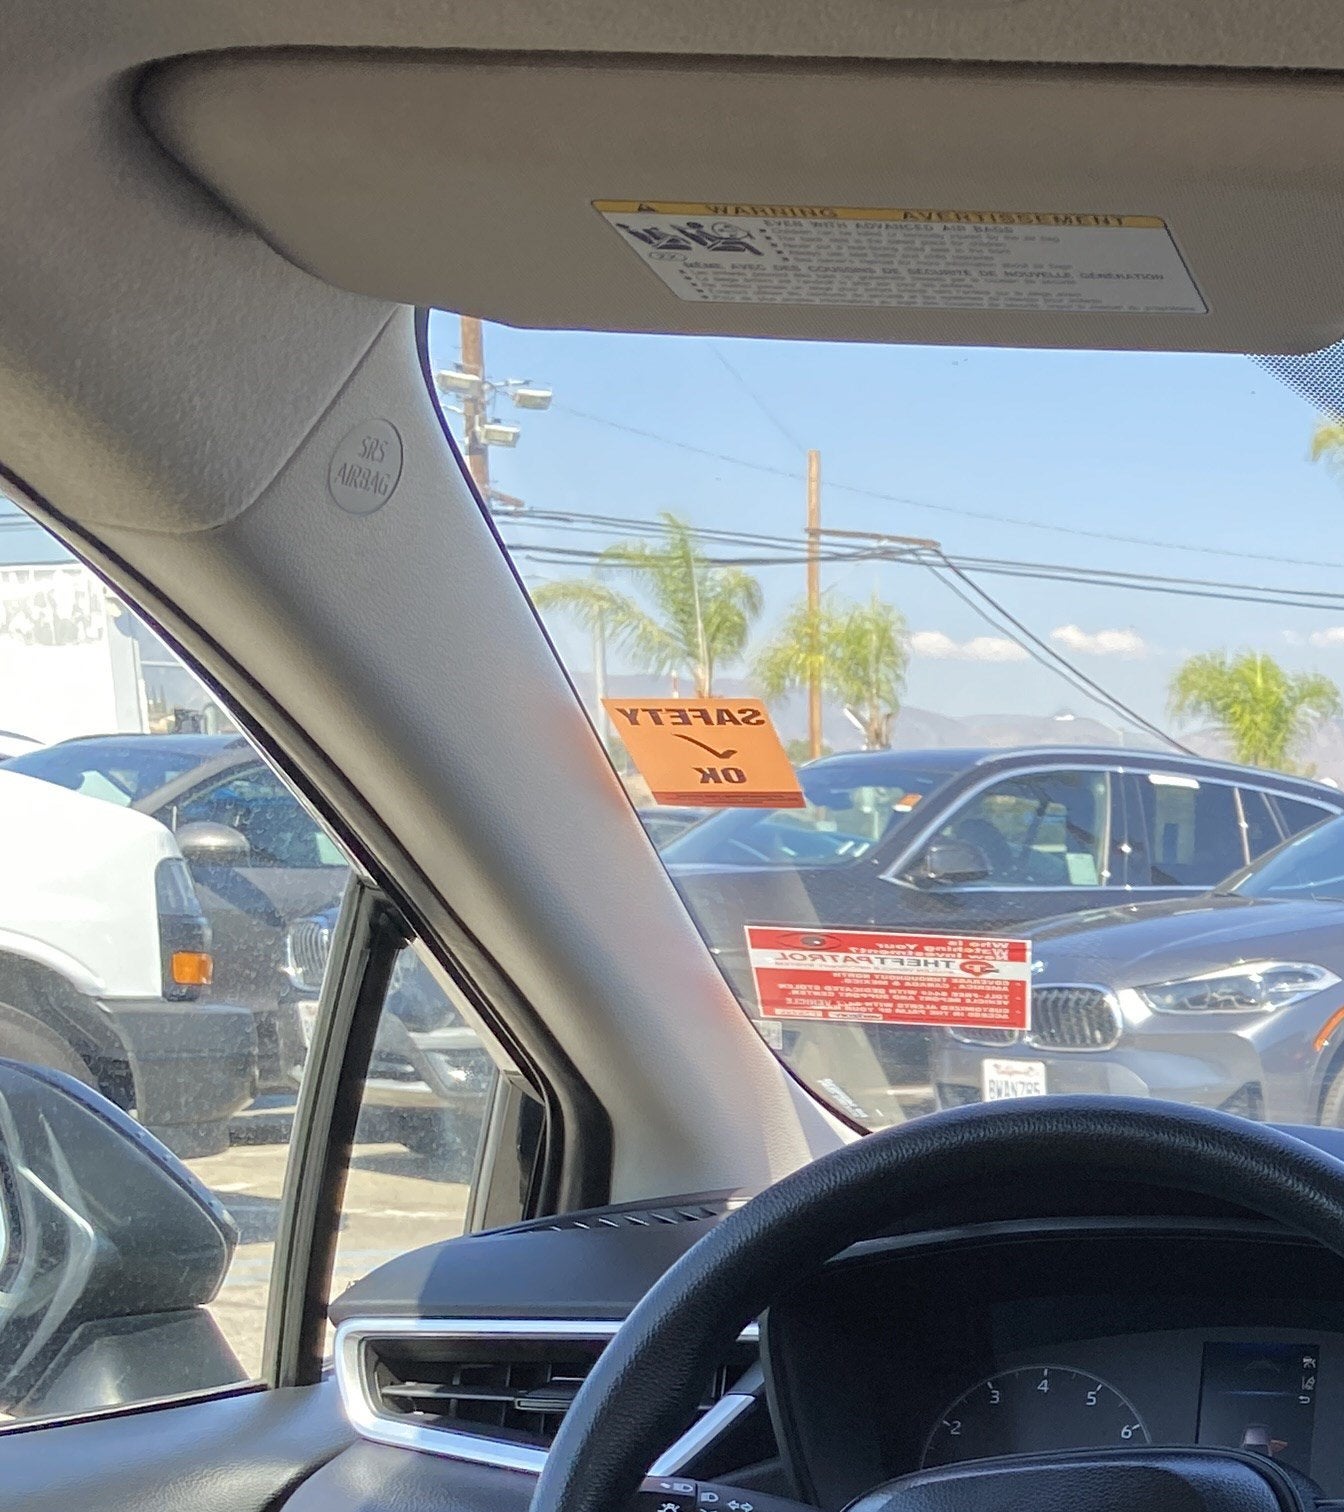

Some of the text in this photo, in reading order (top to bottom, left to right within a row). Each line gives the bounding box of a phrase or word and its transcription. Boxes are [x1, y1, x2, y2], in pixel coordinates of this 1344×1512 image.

[704, 204, 838, 218] WARNING
[358, 435, 388, 463] SRS
[334, 462, 391, 496] AIRBAG
[1037, 1379, 1049, 1393] 4
[990, 1390, 1000, 1404] 3
[1086, 1391, 1097, 1406] 5
[950, 1421, 961, 1435] 2
[1121, 1425, 1133, 1439] 6
